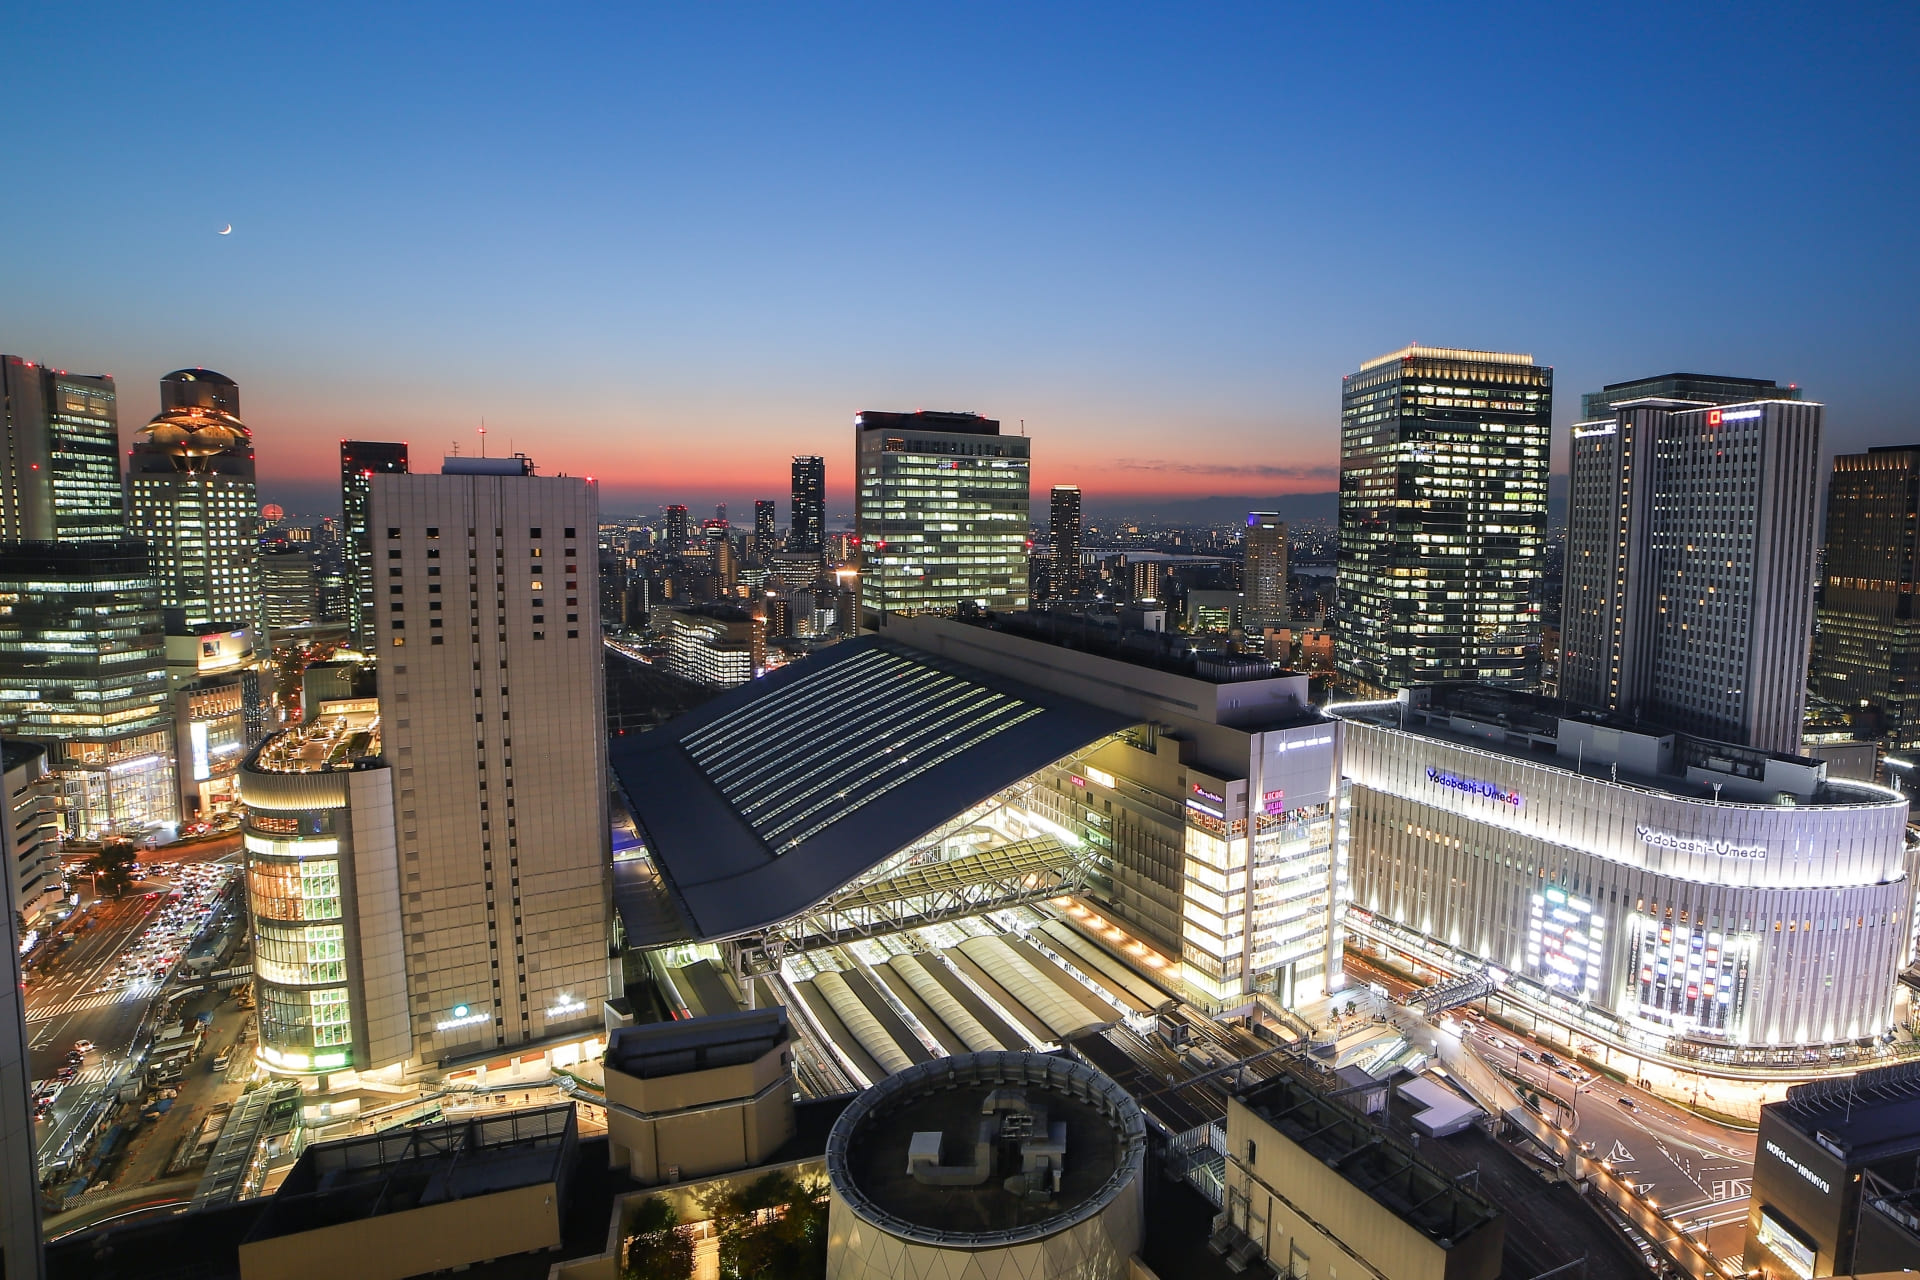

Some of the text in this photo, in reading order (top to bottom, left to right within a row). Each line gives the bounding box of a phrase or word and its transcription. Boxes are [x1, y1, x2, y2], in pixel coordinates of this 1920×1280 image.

[1427, 769, 1519, 805] Yodobashi-Umeda
[1637, 827, 1766, 859] Yodobashi-Umeda
[1766, 1140, 1787, 1163] HOTEL
[1798, 1163, 1830, 1194] HANKYU
